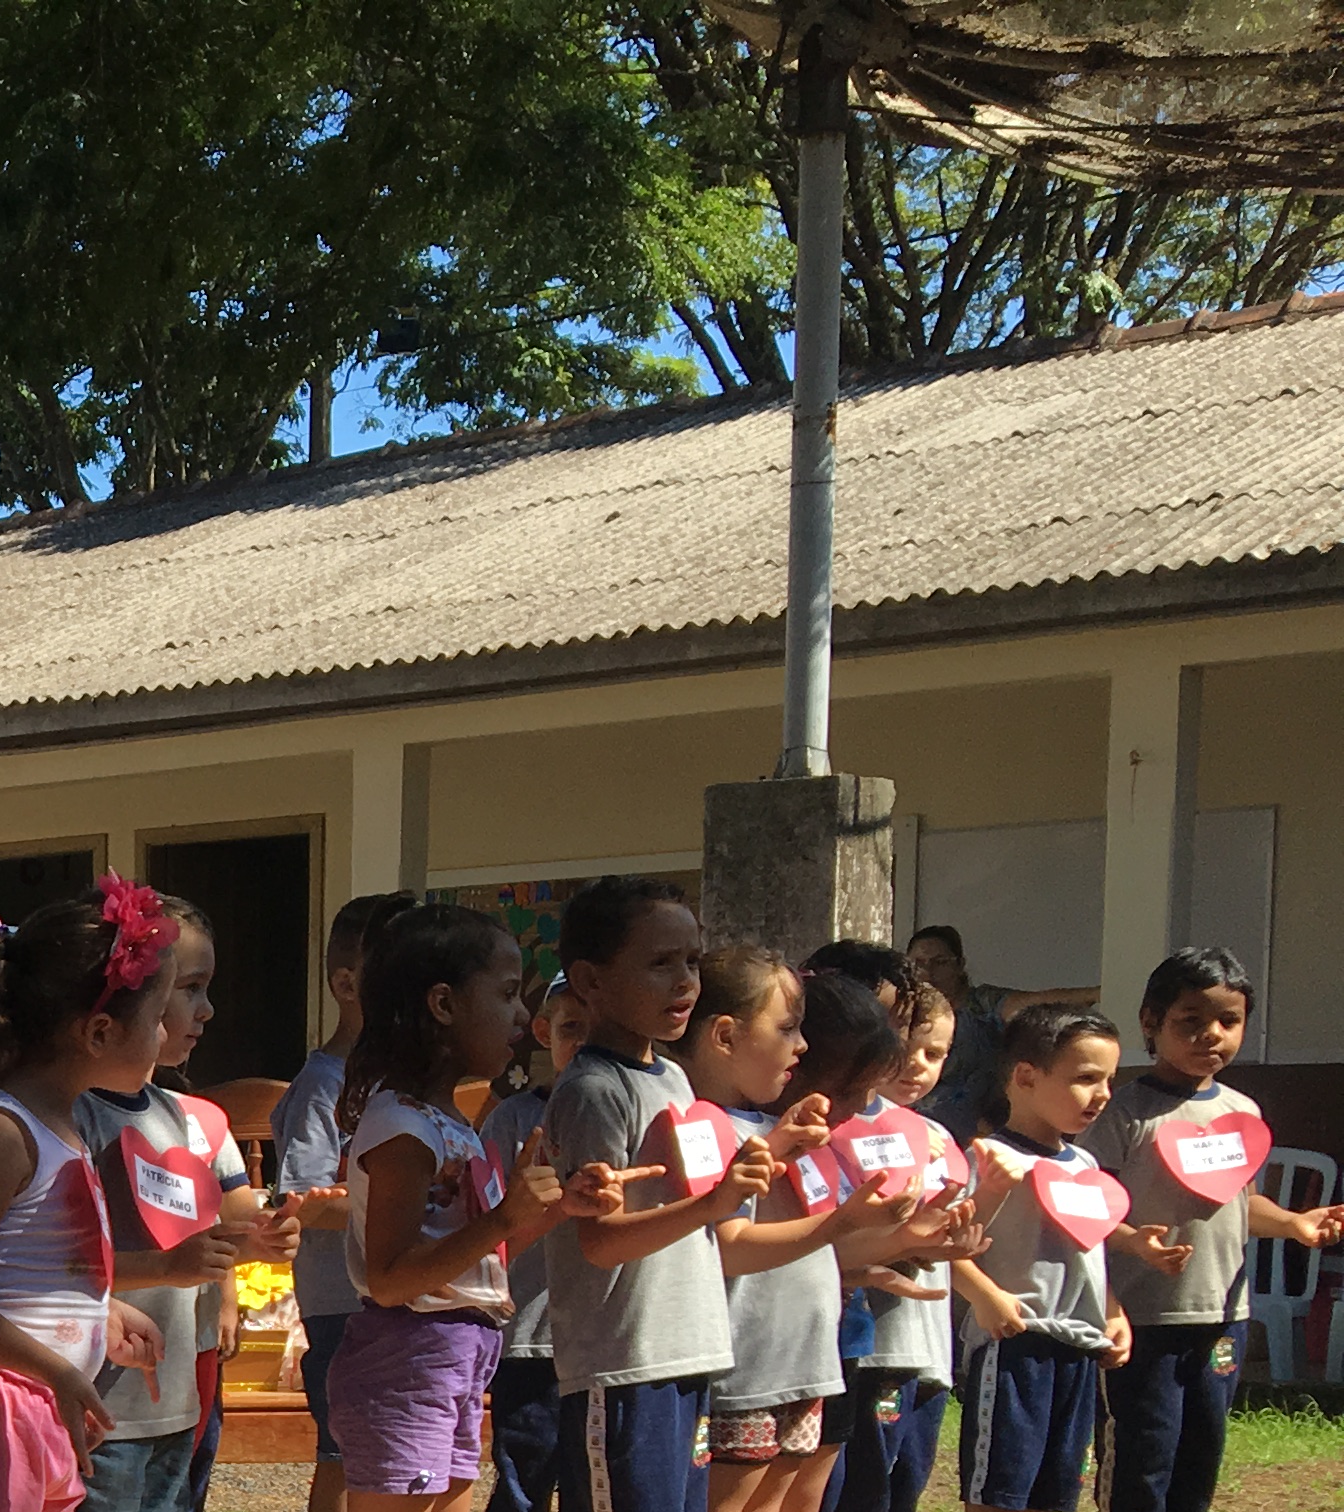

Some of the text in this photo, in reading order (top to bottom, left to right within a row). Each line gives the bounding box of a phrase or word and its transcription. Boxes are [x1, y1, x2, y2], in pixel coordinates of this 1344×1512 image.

[862, 1158, 874, 1167] EU
[878, 1154, 890, 1163] TE
[1201, 1156, 1214, 1165] TE
[1220, 1152, 1244, 1162] AMO
[152, 1192, 164, 1205] TE
[169, 1198, 192, 1213] AMO
